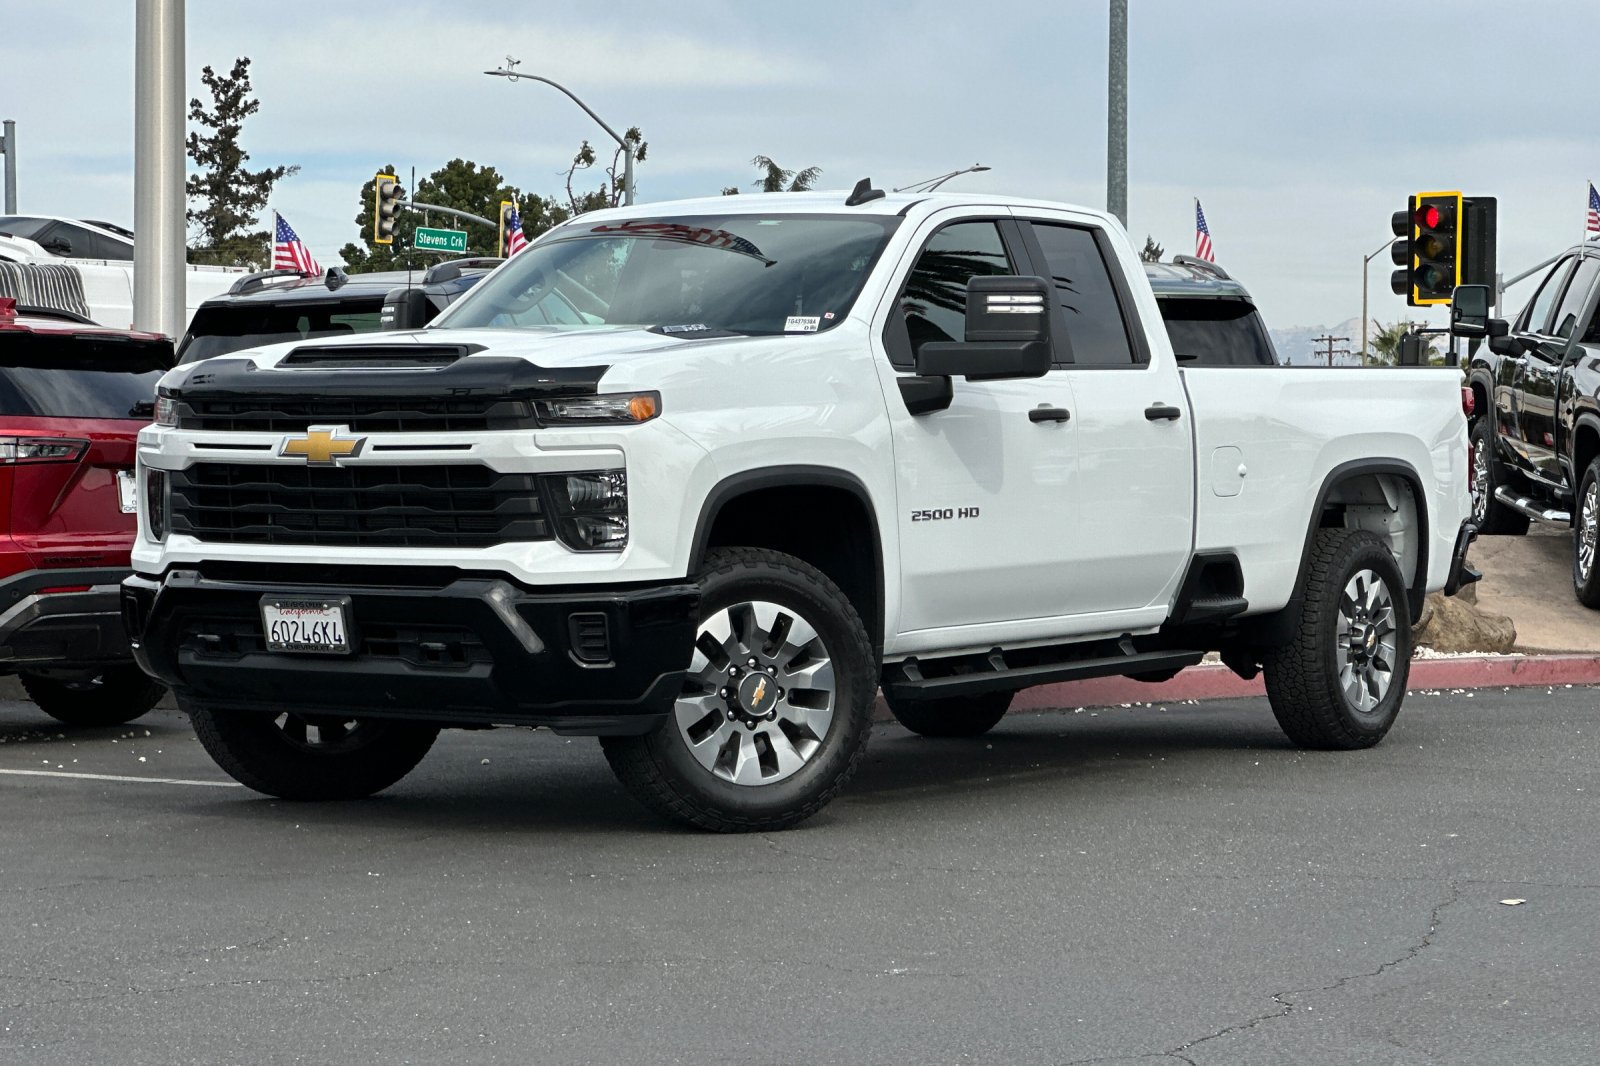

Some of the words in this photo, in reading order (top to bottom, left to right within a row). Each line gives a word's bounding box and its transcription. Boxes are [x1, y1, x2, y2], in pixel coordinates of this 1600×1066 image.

[418, 232, 447, 246] Stevens
[450, 235, 463, 247] Crk
[911, 509, 953, 522] 2500
[958, 507, 979, 519] HD
[271, 620, 343, 645] 60246K4
